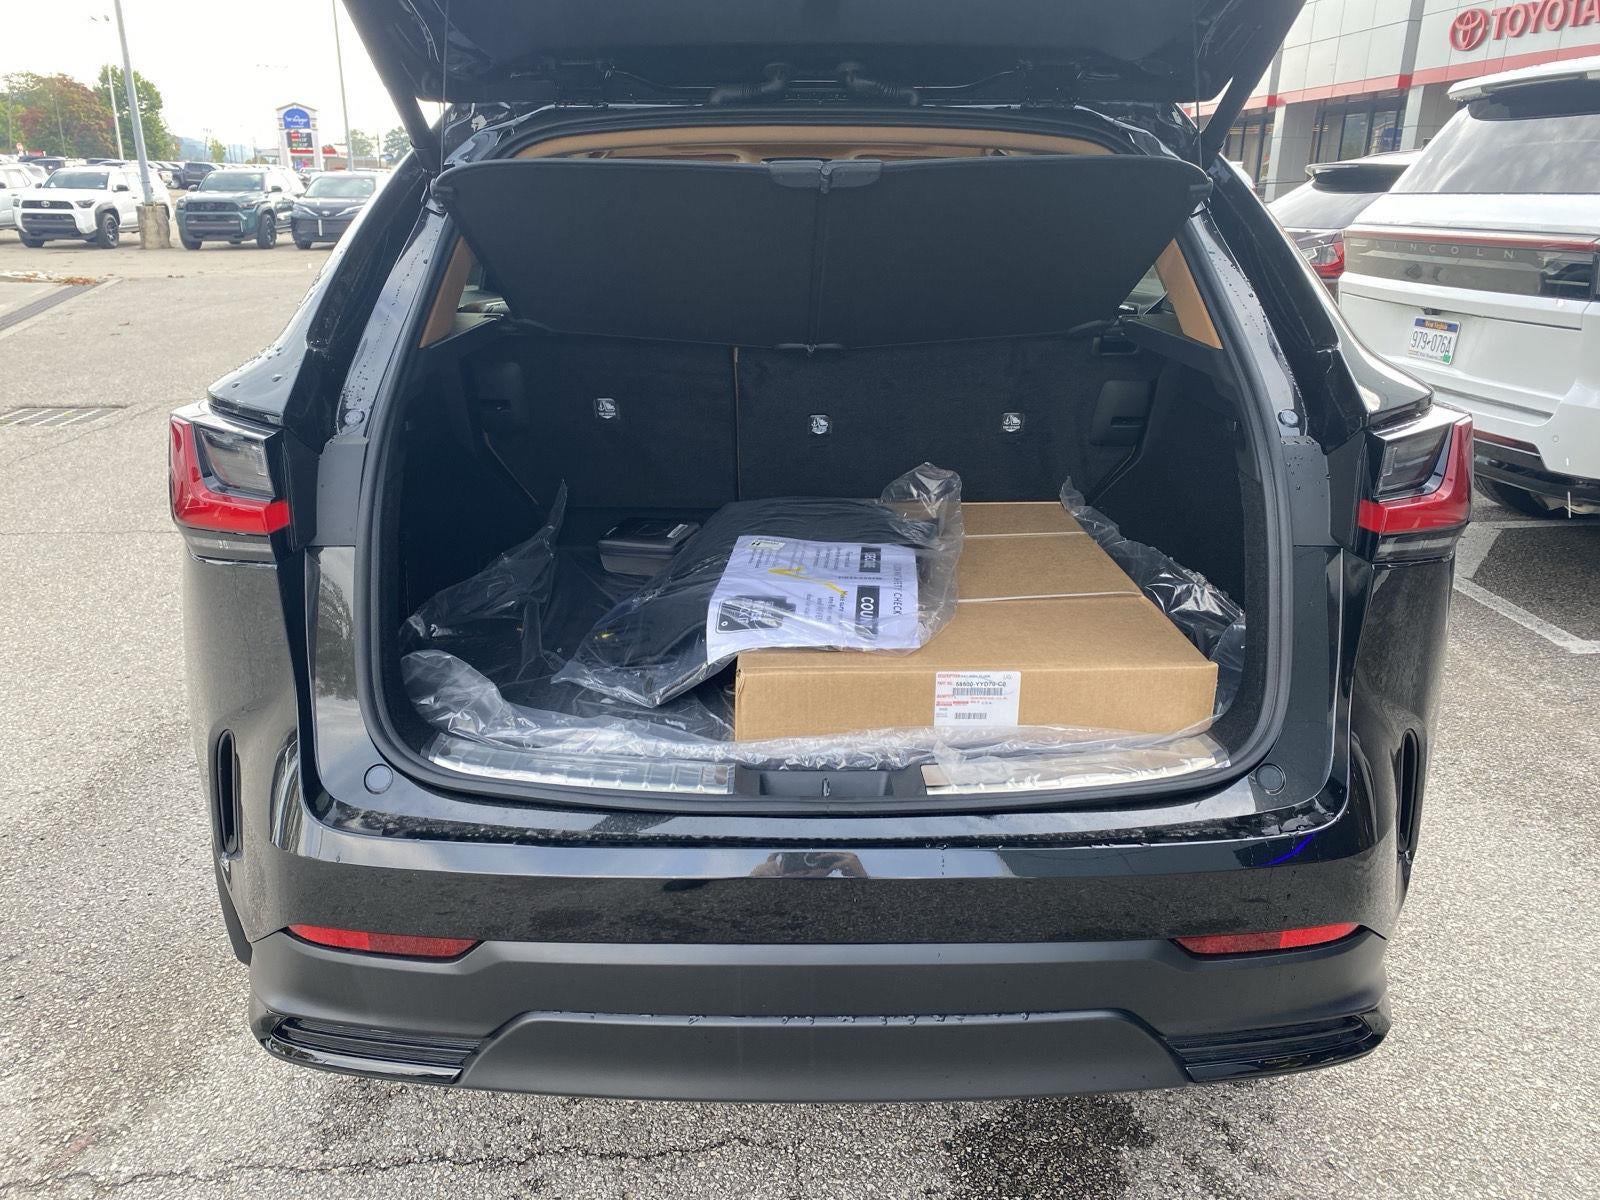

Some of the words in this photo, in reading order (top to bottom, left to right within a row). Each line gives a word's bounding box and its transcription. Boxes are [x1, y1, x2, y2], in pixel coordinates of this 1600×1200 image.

[1491, 0, 1600, 40] TOYOTA
[1375, 240, 1515, 259] LINCOLN
[893, 592, 903, 616] CHECK
